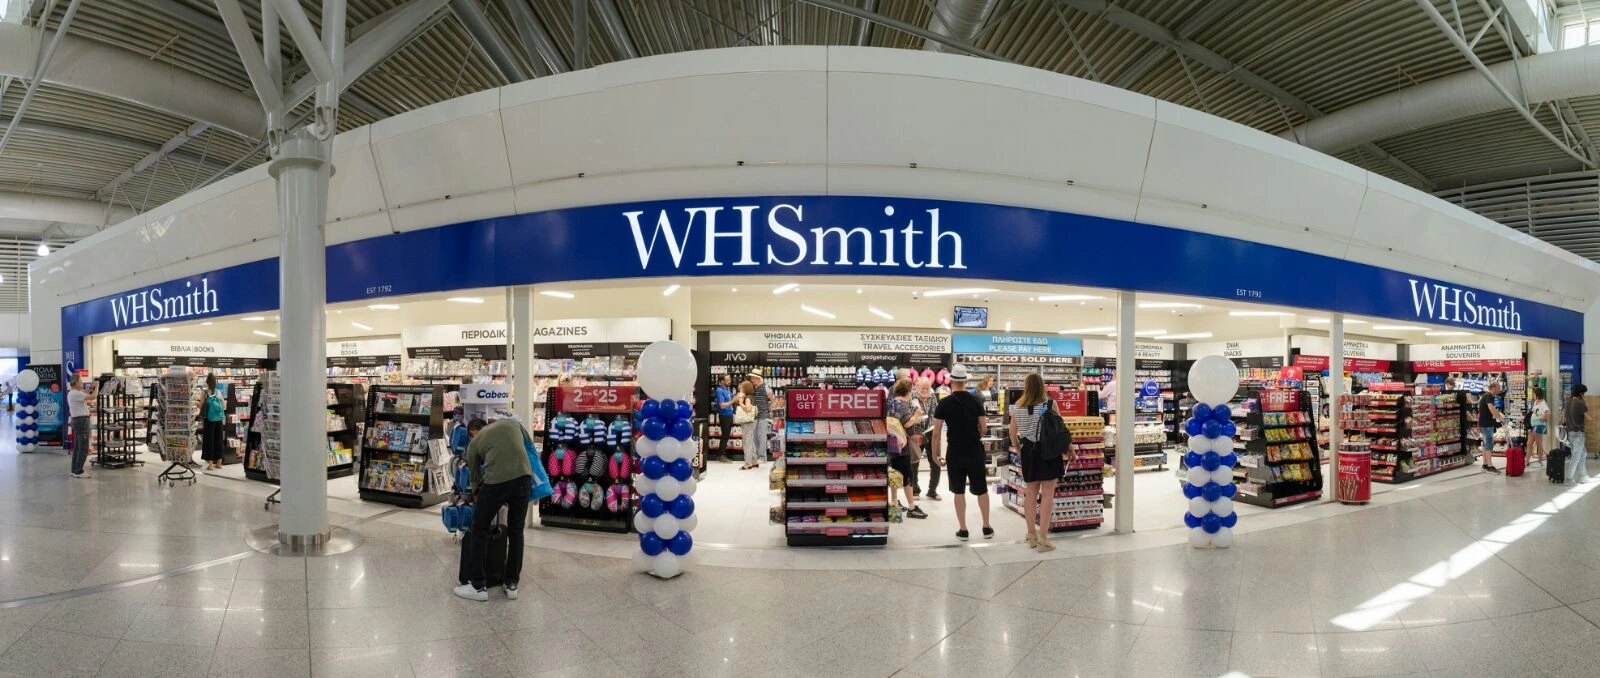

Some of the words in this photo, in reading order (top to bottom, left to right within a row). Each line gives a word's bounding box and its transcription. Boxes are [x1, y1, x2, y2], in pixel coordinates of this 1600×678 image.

[622, 204, 967, 269] WHSmith
[366, 286, 376, 294] EST
[378, 285, 392, 293] 1792
[1236, 288, 1247, 296] EST
[1248, 290, 1262, 298] 1792
[110, 278, 219, 328] WHSmith
[1408, 279, 1522, 331] WHSmith
[461, 329, 507, 339] ΠΕΡΙΟΔΙΚ
[533, 327, 588, 336] AGAZINES
[860, 334, 912, 342] ΣΥΣΚΕΥΑΣΙΕΣ
[914, 335, 949, 343] ΤΑΞΙΔΙΟΥ
[992, 336, 1031, 344] ΠΛΗΡΩΣΤΕ
[724, 353, 747, 361] JIVO
[573, 389, 583, 402] 2
[592, 389, 618, 403] €25
[828, 393, 878, 409] FREE
[1269, 391, 1295, 403] FREE
